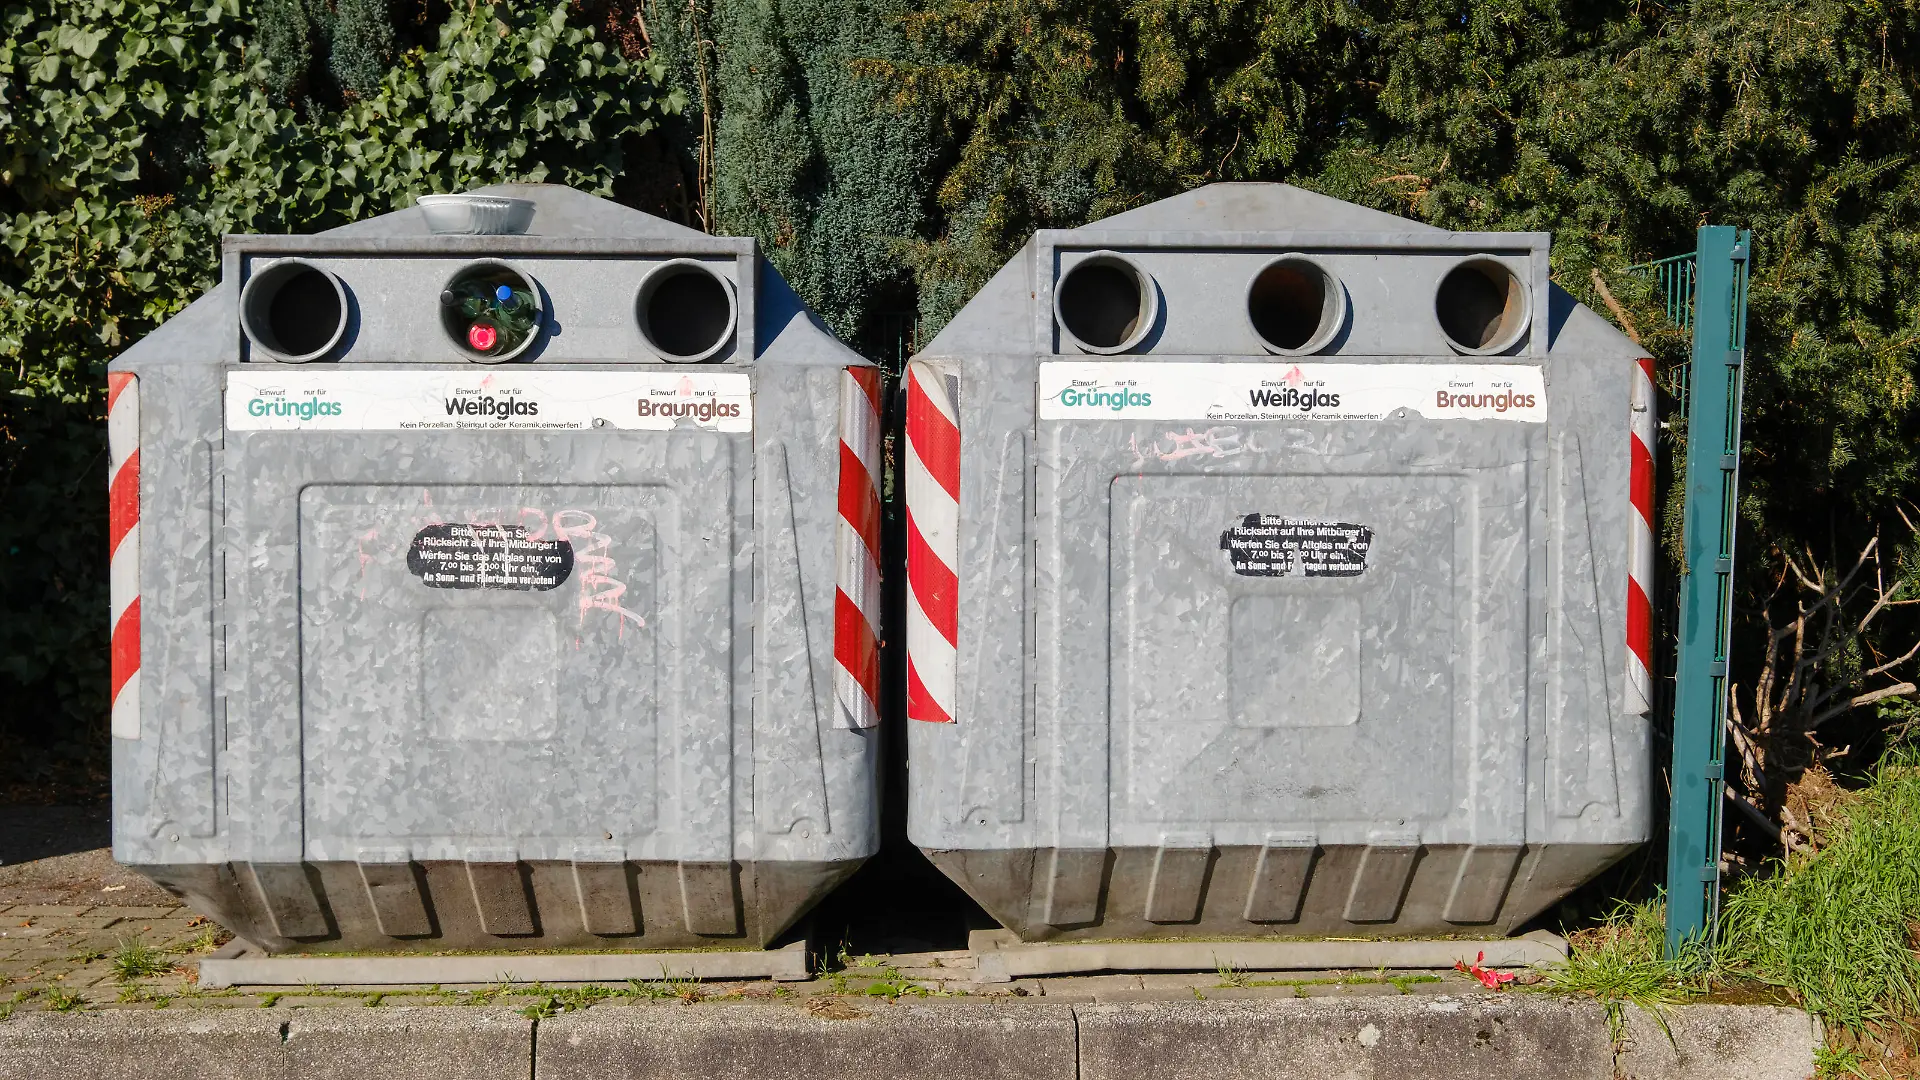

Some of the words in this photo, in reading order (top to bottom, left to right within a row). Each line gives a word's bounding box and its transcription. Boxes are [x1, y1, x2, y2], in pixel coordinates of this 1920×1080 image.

[1071, 379, 1098, 387] Einwurf
[1127, 379, 1138, 387] für
[1448, 380, 1474, 388] Einwurf
[1503, 380, 1513, 388] für
[259, 388, 286, 396] Einwurf
[316, 387, 327, 396] für
[455, 387, 482, 396] Einwurf
[512, 387, 523, 395] für
[707, 389, 717, 397] für
[1061, 387, 1152, 411] Grünglas
[1249, 388, 1340, 411] Weißglas
[1436, 389, 1536, 412] Braunglas
[248, 396, 343, 421] Grünglas
[445, 395, 539, 421] Weißglas
[637, 397, 741, 422] Braunglas
[1206, 412, 1223, 420] Kein
[1260, 412, 1291, 421] Steingut
[1292, 412, 1310, 420] oder
[1311, 412, 1341, 420] Keramik
[399, 421, 417, 429] Kein
[456, 421, 488, 430] Steingut
[489, 421, 507, 429] oder
[1260, 516, 1282, 526] Bitte
[450, 527, 474, 537] Bitte
[515, 529, 531, 539] Sie
[1234, 526, 1279, 536] Rücksicht
[1279, 526, 1296, 536] auf
[1297, 526, 1315, 536] Ihre
[422, 536, 469, 547] Rücksicht
[470, 538, 487, 548] auf
[488, 538, 507, 548] Ihre
[1230, 539, 1263, 549] Werfen
[1264, 539, 1280, 549] Sie
[1281, 539, 1299, 549] das
[1301, 540, 1333, 550] Altglas
[1334, 541, 1350, 549] nur
[1351, 541, 1368, 550] von
[418, 550, 453, 560] Werfen
[454, 551, 471, 561] Sie
[472, 551, 490, 562] das
[492, 552, 525, 563] Altglas
[526, 555, 543, 563] nur
[544, 555, 562, 564] von
[1270, 550, 1285, 559] bis
[1310, 550, 1328, 560] Uhr
[459, 561, 475, 572] bis
[501, 562, 519, 573] Uhr
[1235, 560, 1246, 570] An
[1247, 560, 1270, 570] Sonn-
[1271, 562, 1286, 570] und
[1287, 561, 1327, 571] Frtagen
[1328, 561, 1364, 571] verboten!
[423, 571, 434, 582] An
[435, 572, 459, 582] Sonn-
[460, 573, 475, 583] und
